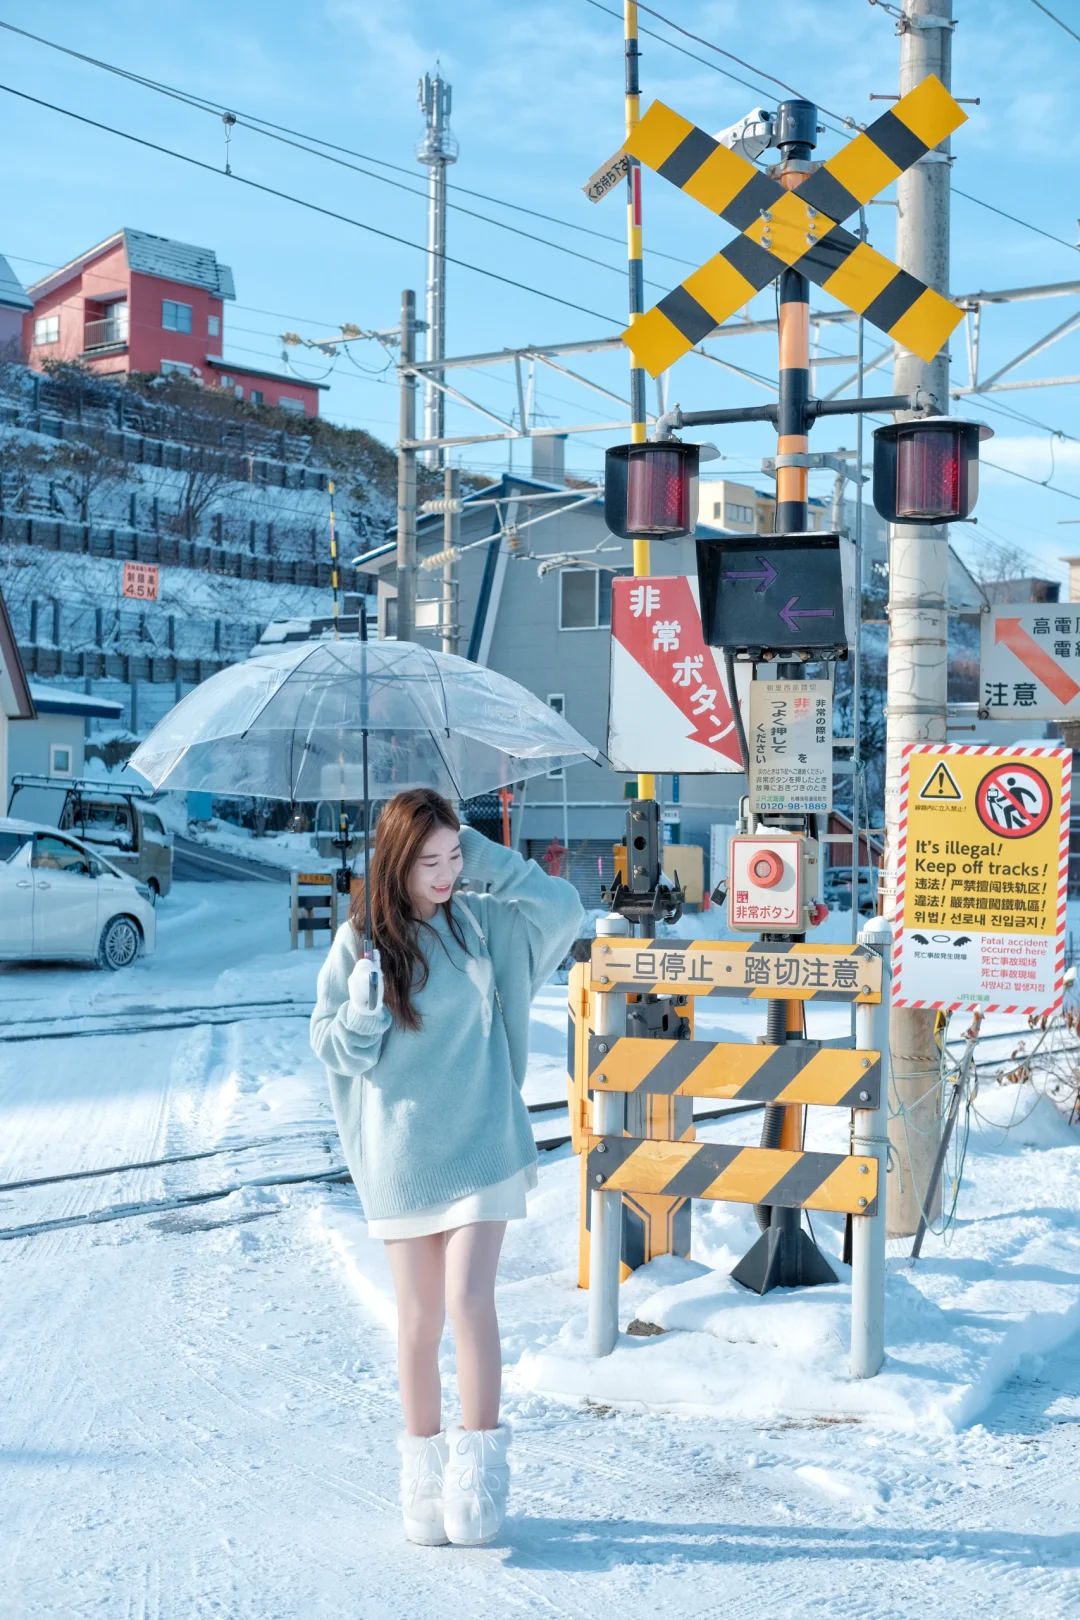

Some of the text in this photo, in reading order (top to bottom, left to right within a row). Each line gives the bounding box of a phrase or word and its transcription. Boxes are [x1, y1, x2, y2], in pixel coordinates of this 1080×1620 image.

[1033, 617, 1080, 635] 高電
[629, 585, 736, 743] 非常ボタン
[985, 682, 1037, 706] 注意
[771, 701, 787, 754] つよく押して
[816, 699, 826, 743] 非常の際は
[756, 723, 766, 764] ください
[756, 776, 828, 784] 非常ボタンを押したとき
[756, 784, 827, 792] 故障におきづきのとき
[915, 840, 1003, 859] It's illegal!
[915, 858, 1048, 877] Keep off tracks!
[736, 905, 795, 919] 非常ボタン
[950, 913, 986, 926] 선로내
[981, 937, 1048, 947] Fatal accident
[981, 946, 1046, 955] occurred here
[914, 951, 967, 960] 死亡事故発生現場
[605, 952, 859, 989] 一旦停止・踏切注意
